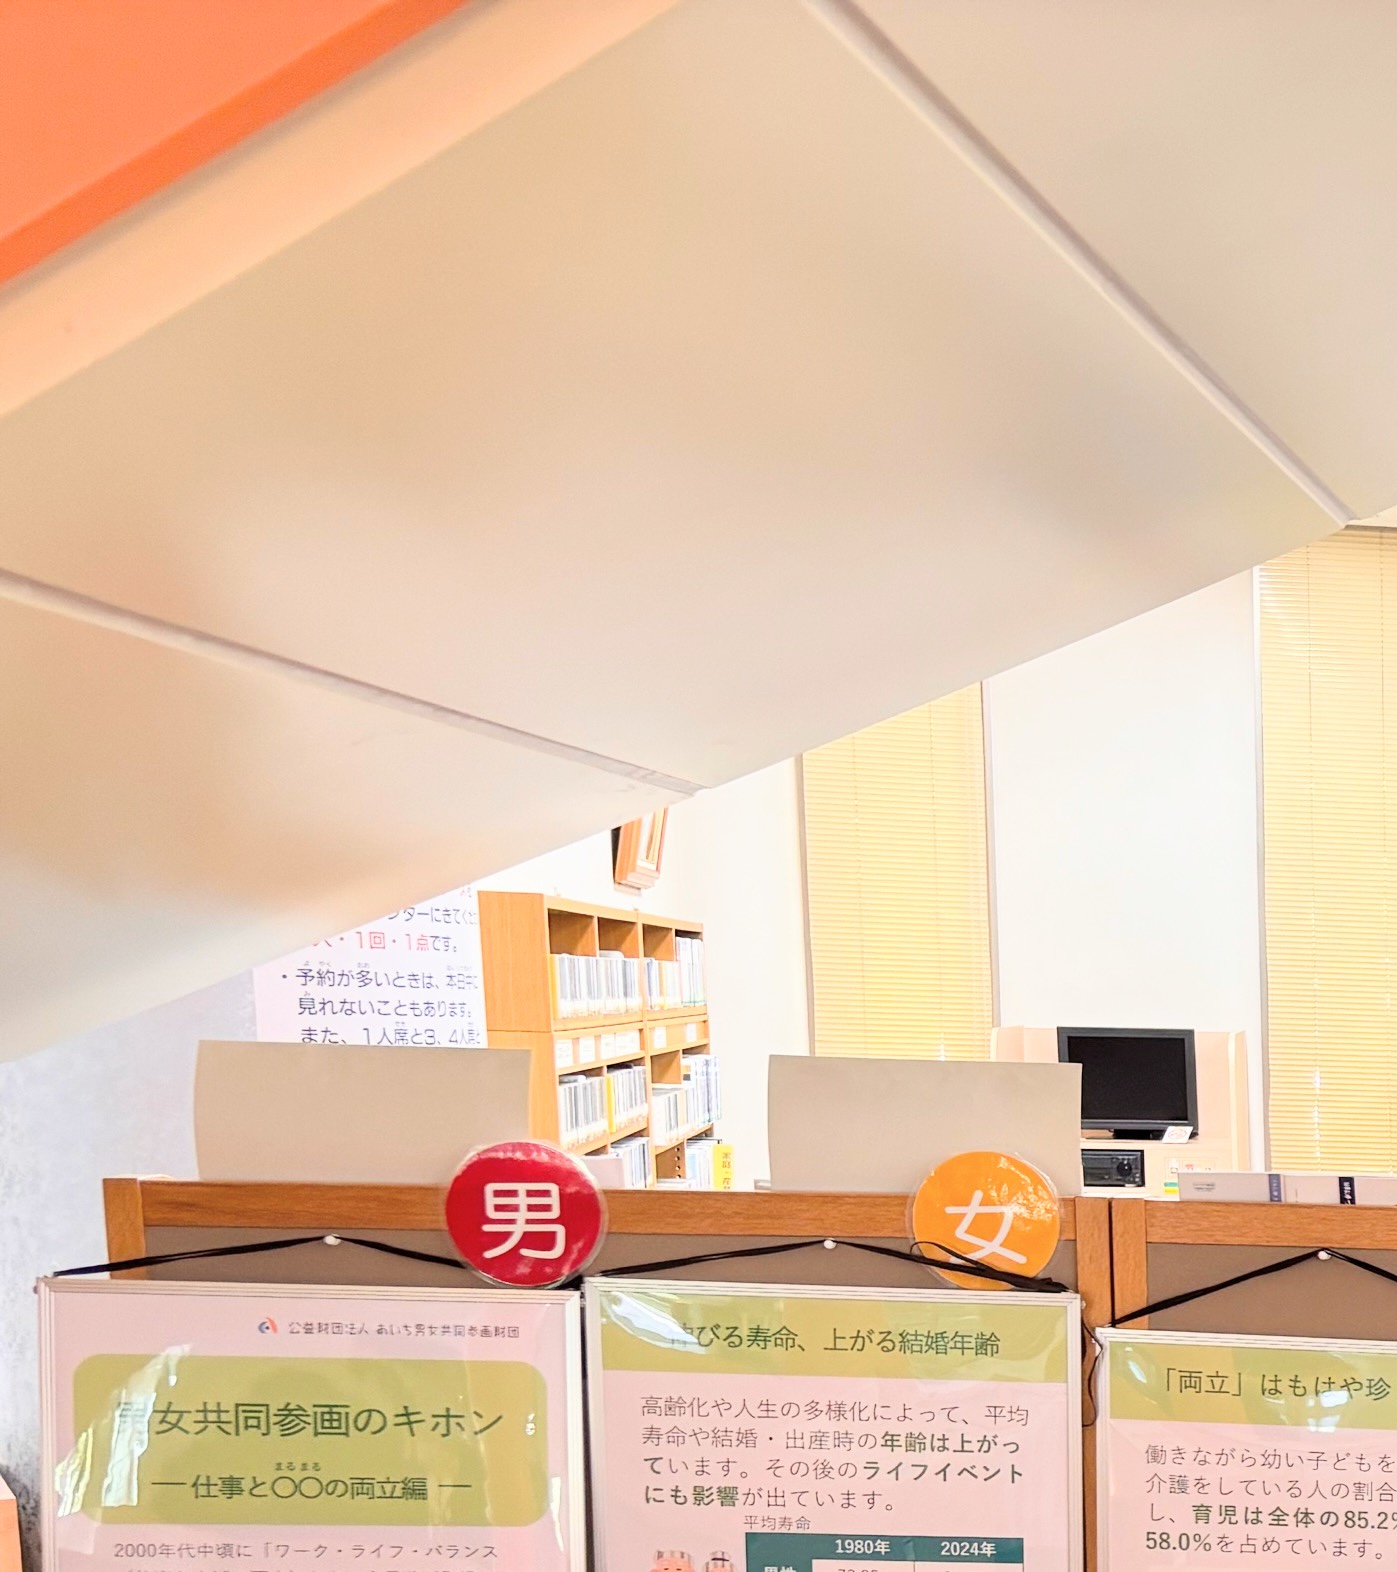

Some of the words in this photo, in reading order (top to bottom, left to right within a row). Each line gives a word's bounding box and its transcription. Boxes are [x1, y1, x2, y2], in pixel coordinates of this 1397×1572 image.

[482, 1181, 566, 1260] 男
[945, 1189, 1028, 1265] 女
[641, 1395, 1028, 1427] 高齢化や人生の多様化によって、平均
[645, 1456, 1024, 1484] ています。その後のライフイベント
[644, 1484, 896, 1511] にも影響が出ています。
[743, 1515, 811, 1532] 平均寿命
[834, 1538, 890, 1556] 1980年
[940, 1540, 996, 1557] 2024年
